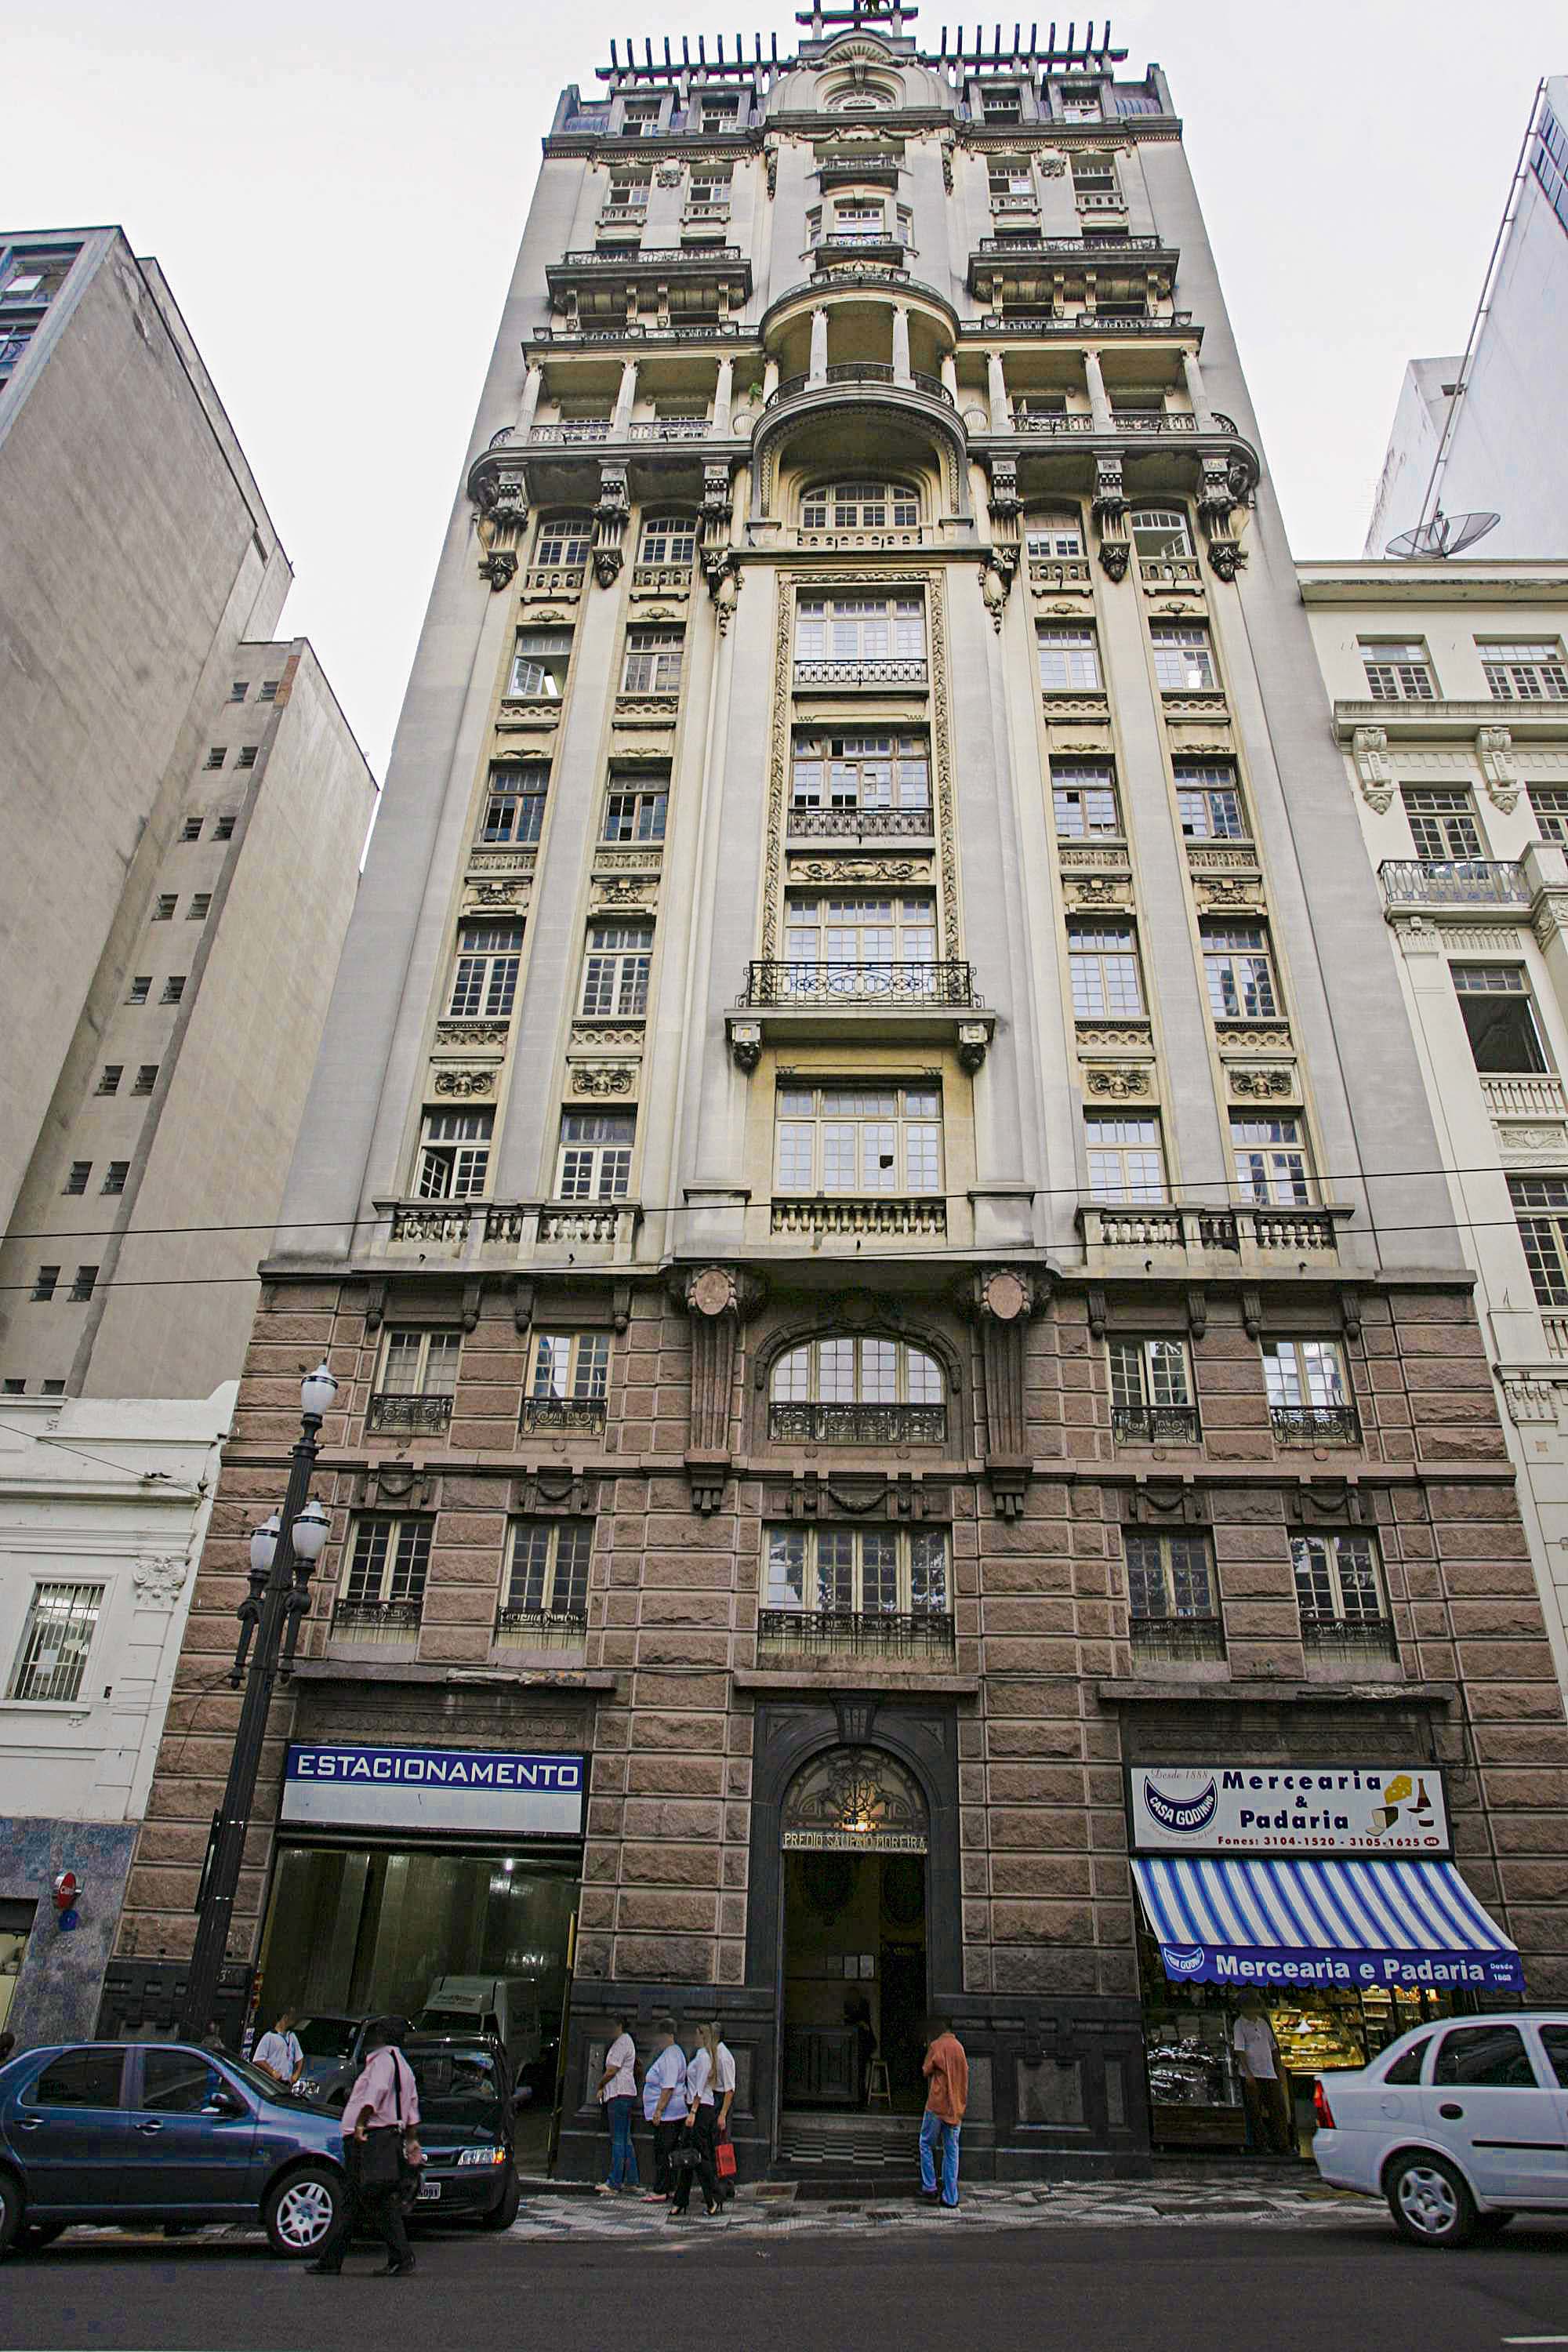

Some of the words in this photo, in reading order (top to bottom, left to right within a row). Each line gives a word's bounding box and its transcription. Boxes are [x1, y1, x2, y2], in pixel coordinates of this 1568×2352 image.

[297, 1755, 578, 1787] ESTACIONAMENTO
[1185, 1769, 1209, 1780] 1888
[1222, 1769, 1381, 1790] Mercearia
[1149, 1796, 1174, 1823] CASA
[1177, 1795, 1214, 1825] GODINHO
[1295, 1795, 1308, 1809] &
[1240, 1809, 1348, 1829] Padaria
[1218, 1836, 1259, 1846] Fones:
[1264, 1837, 1335, 1846] 3104-1520
[1350, 1838, 1420, 1846] 3105-1625
[1216, 1954, 1350, 1978] Mercearia
[1359, 1962, 1375, 1979] e
[1383, 1958, 1484, 1980] Padaria
